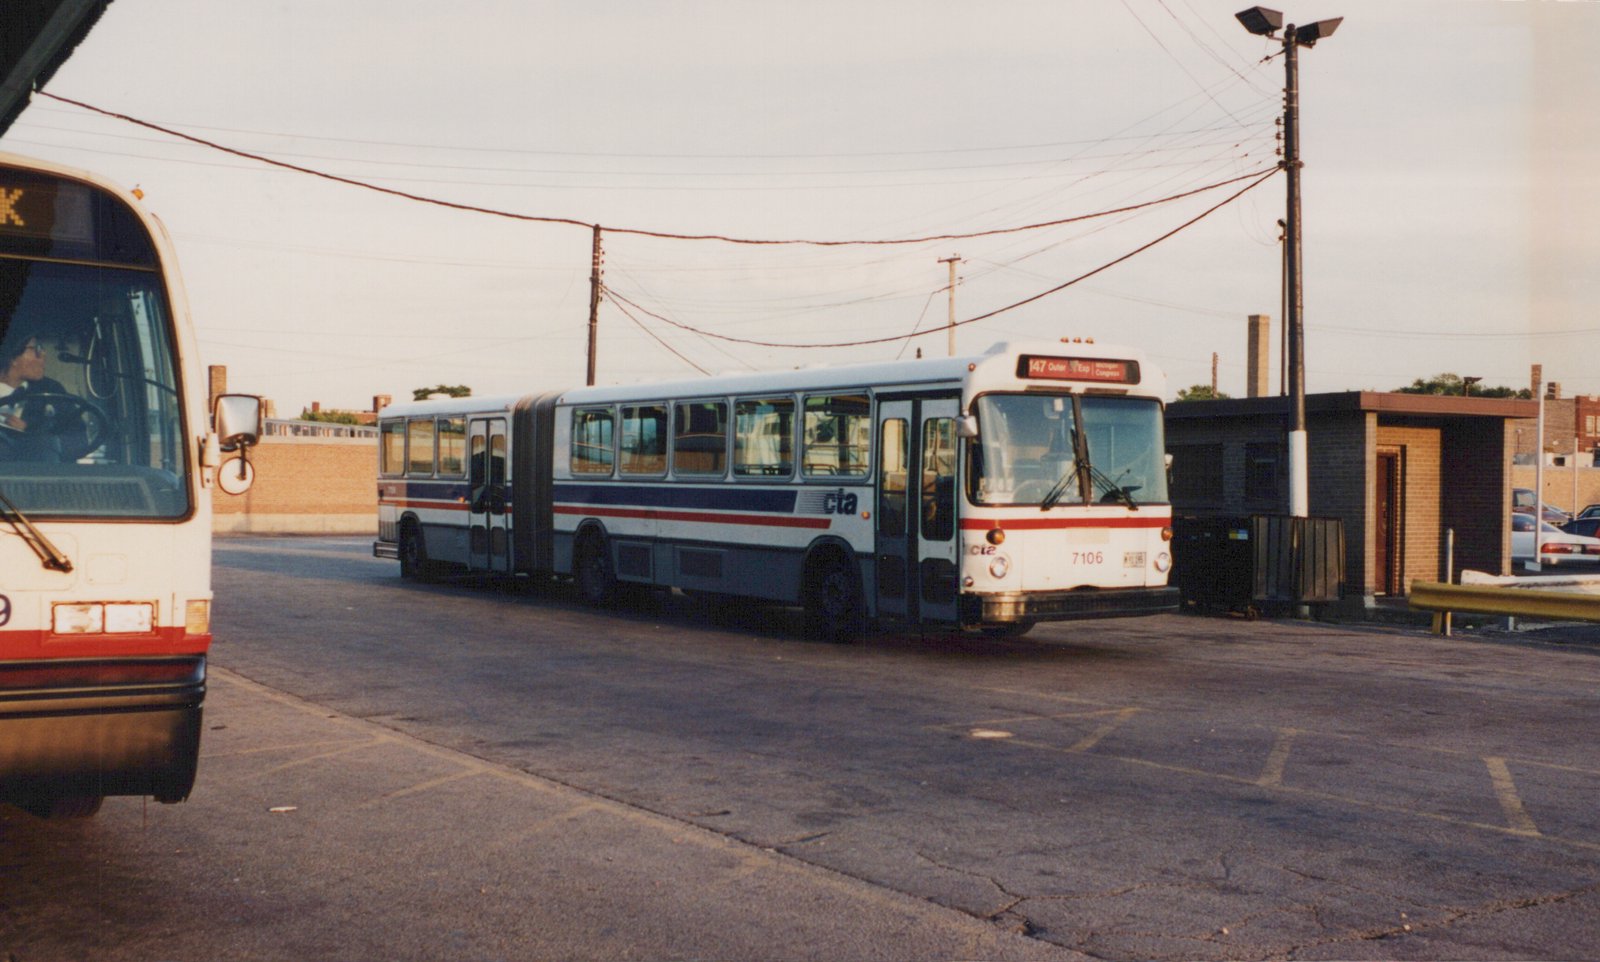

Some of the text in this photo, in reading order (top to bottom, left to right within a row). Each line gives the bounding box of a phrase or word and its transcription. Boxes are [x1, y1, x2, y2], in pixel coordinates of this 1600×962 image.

[1029, 359, 1047, 373] 147
[1048, 362, 1066, 372] Outer
[823, 488, 858, 515] cta
[1072, 552, 1103, 564] 7106
